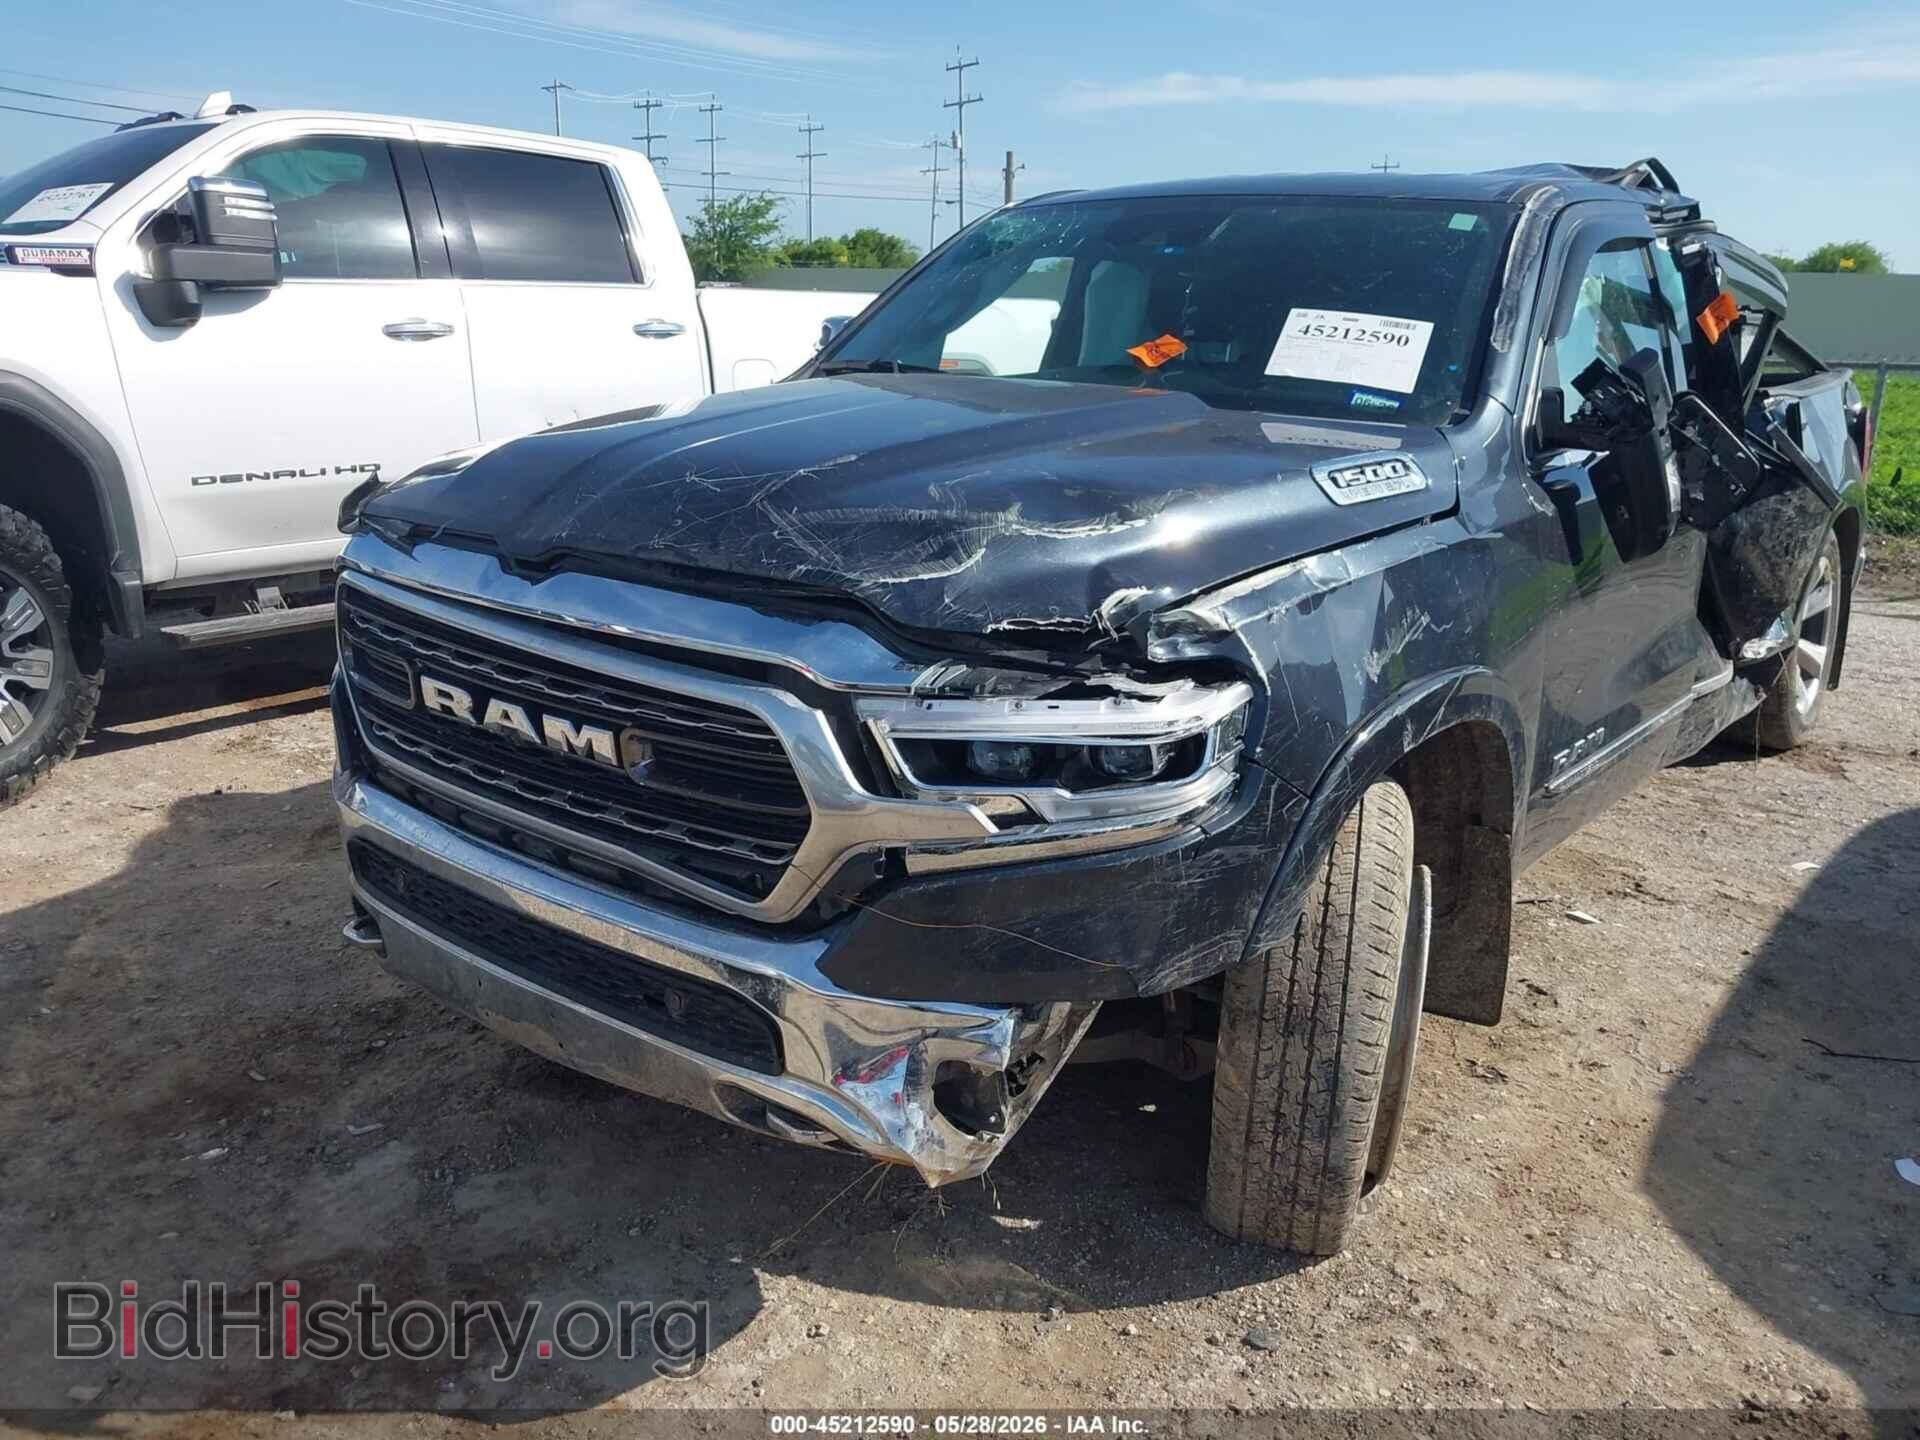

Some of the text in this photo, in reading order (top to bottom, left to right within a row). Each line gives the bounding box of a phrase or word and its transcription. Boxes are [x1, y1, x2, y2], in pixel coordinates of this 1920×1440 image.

[22, 248, 84, 258] DURAMAX
[1297, 324, 1411, 347] 45212590
[191, 463, 382, 487] DENALI HD
[1331, 462, 1406, 487] 1500
[419, 675, 620, 768] RAM
